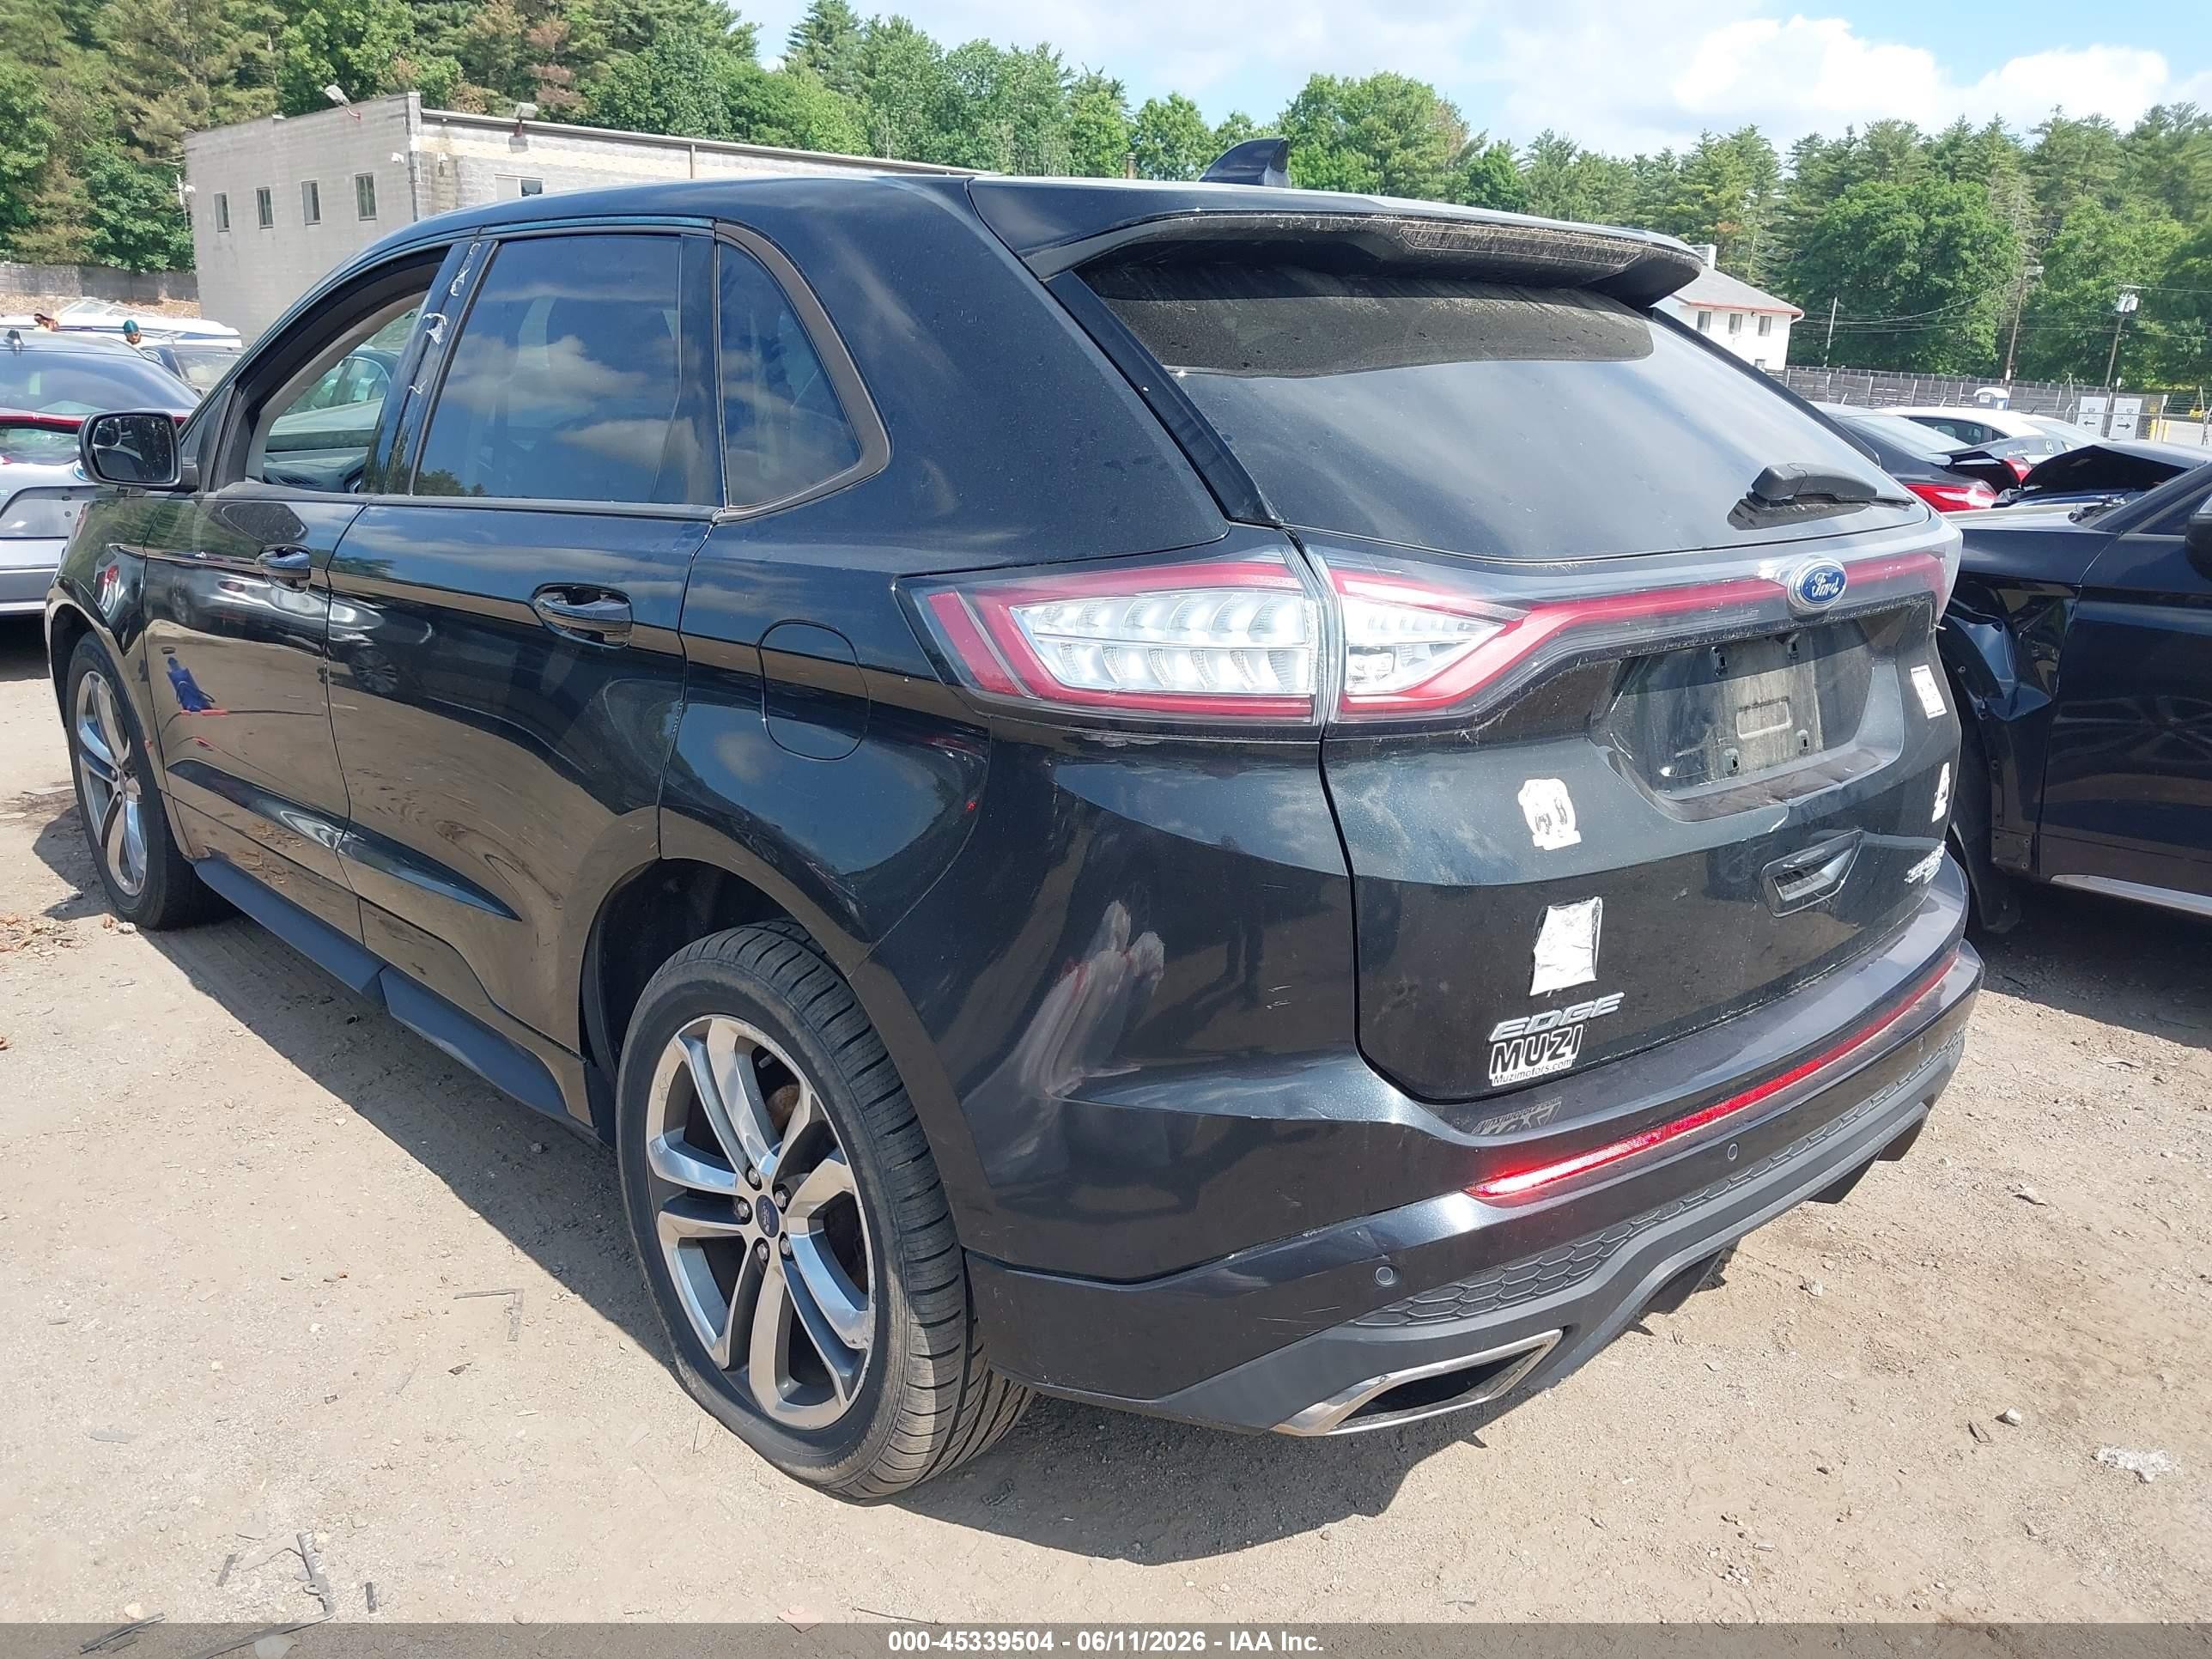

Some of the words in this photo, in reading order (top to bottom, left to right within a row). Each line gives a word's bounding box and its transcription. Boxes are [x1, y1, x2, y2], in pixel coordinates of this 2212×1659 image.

[1812, 572, 1839, 598] Ford
[1489, 992, 1626, 1042] EDGE
[1491, 1025, 1583, 1075] MUZI
[1493, 1058, 1571, 1085] Muzimotors.com
